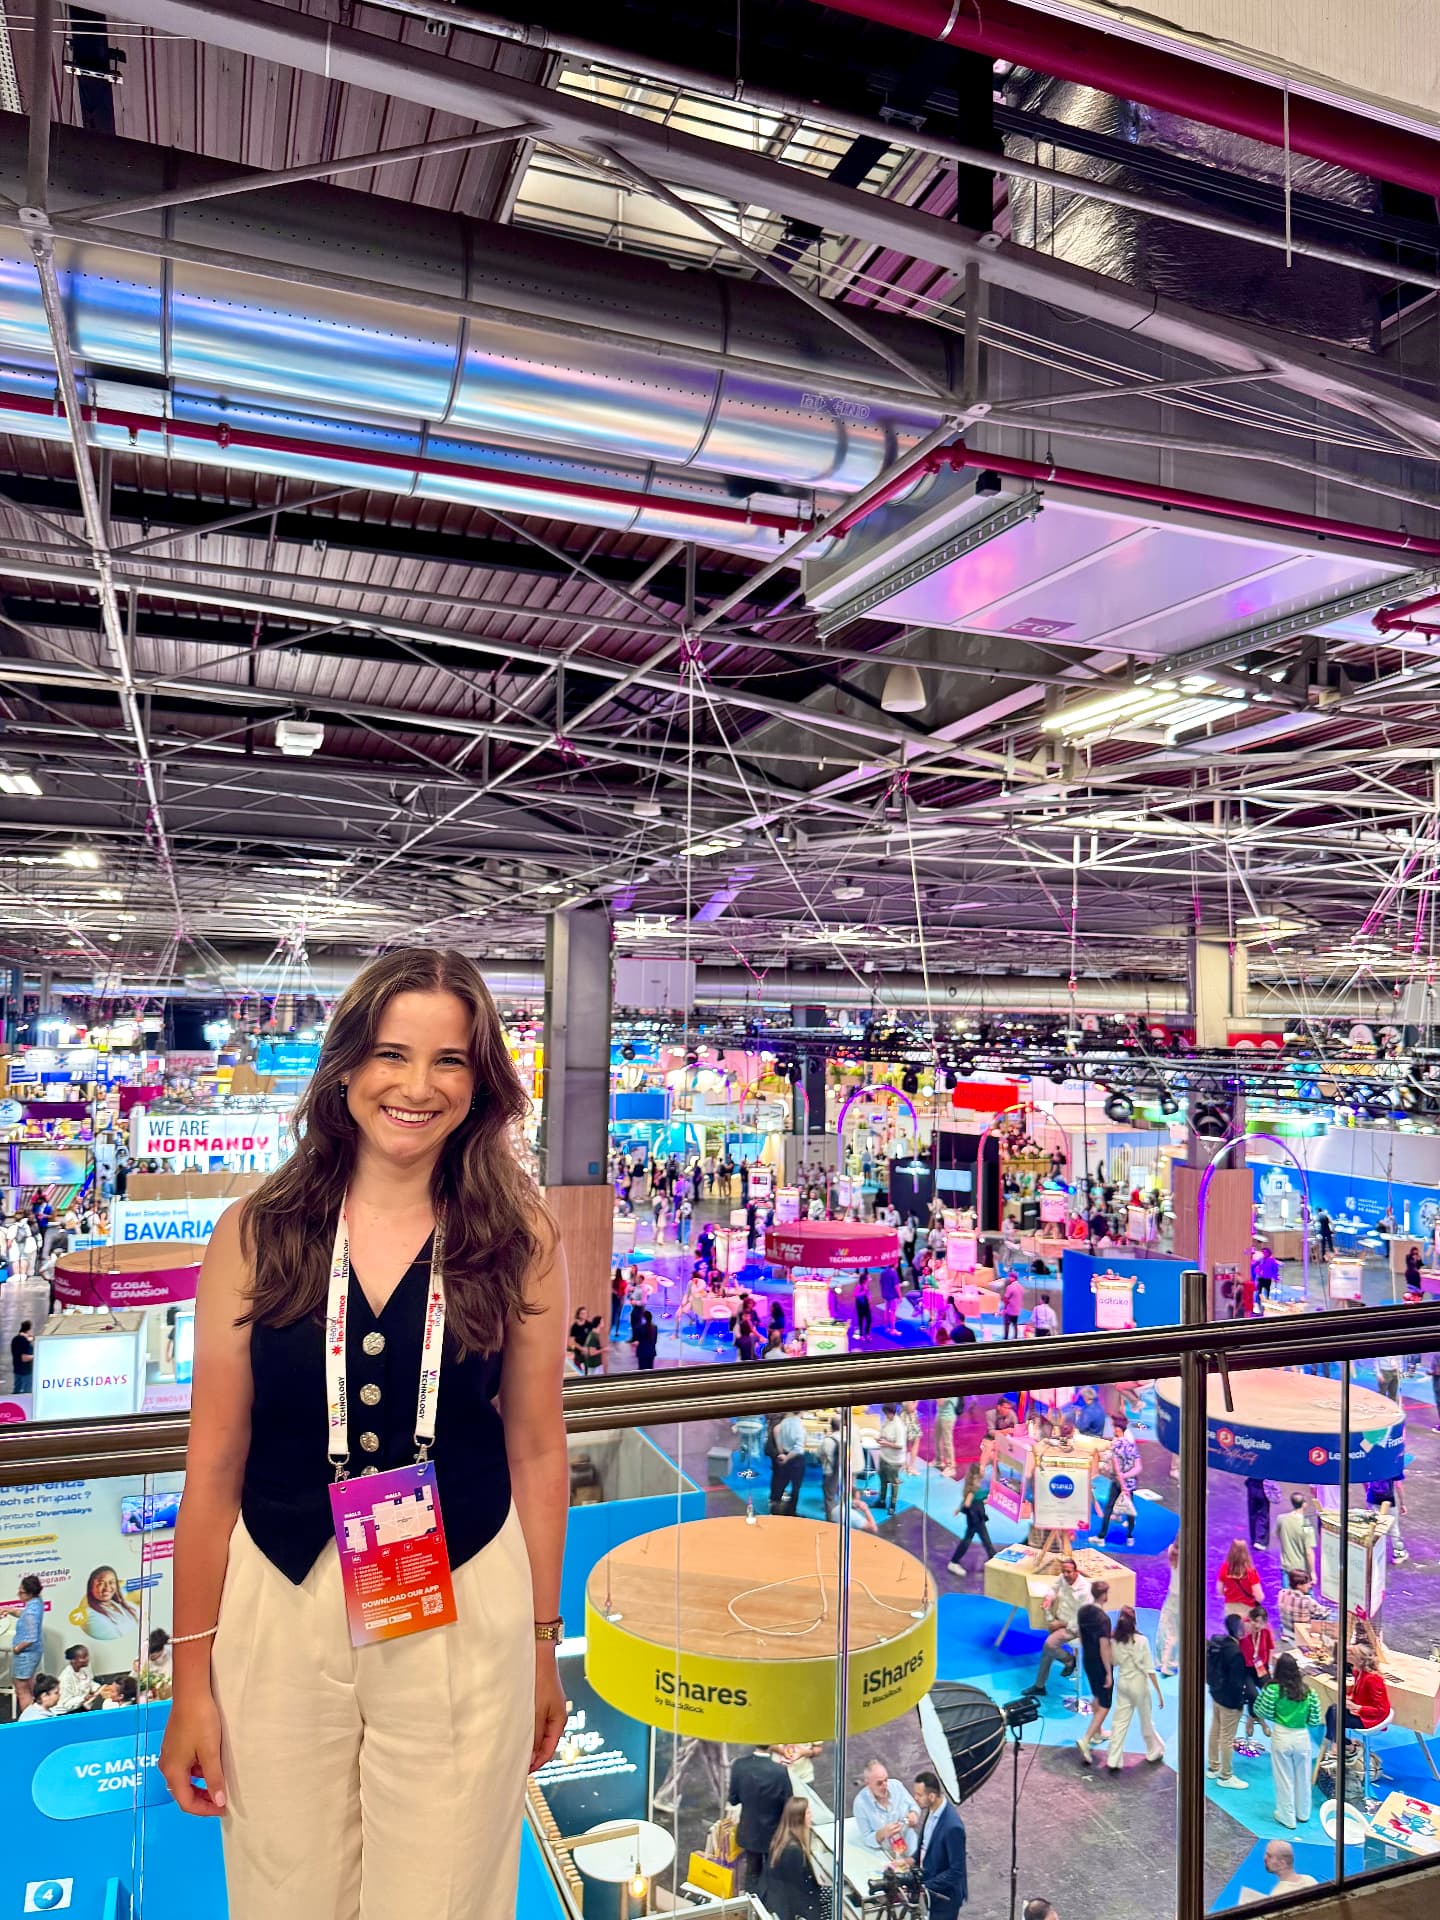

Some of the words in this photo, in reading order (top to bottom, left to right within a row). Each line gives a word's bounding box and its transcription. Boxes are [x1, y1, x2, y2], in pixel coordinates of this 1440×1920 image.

[149, 1119, 175, 1136] WE
[179, 1119, 210, 1136] ARE
[147, 1135, 270, 1153] NORMANDY
[124, 1219, 213, 1241] BAVARIA
[110, 1280, 153, 1291] GLOBAL
[110, 1286, 169, 1299] EXPANSION
[42, 1374, 128, 1389] DIVERSIDAYS
[427, 1369, 438, 1394] VIVA
[338, 1376, 347, 1427] TECHNOLOGY
[418, 1369, 429, 1420] TECHNOLOGY
[331, 1402, 341, 1428] VIVA
[1234, 1435, 1273, 1451] Digitale
[361, 1592, 407, 1609] DOWNLOAD
[406, 1588, 424, 1599] OUR
[424, 1584, 440, 1595] APP
[863, 1650, 924, 1695] iShares
[655, 1669, 749, 1707] iShares
[654, 1695, 664, 1705] by
[75, 1763, 102, 1779] VC
[97, 1772, 143, 1793] ZONE
[42, 1888, 54, 1901] 4
